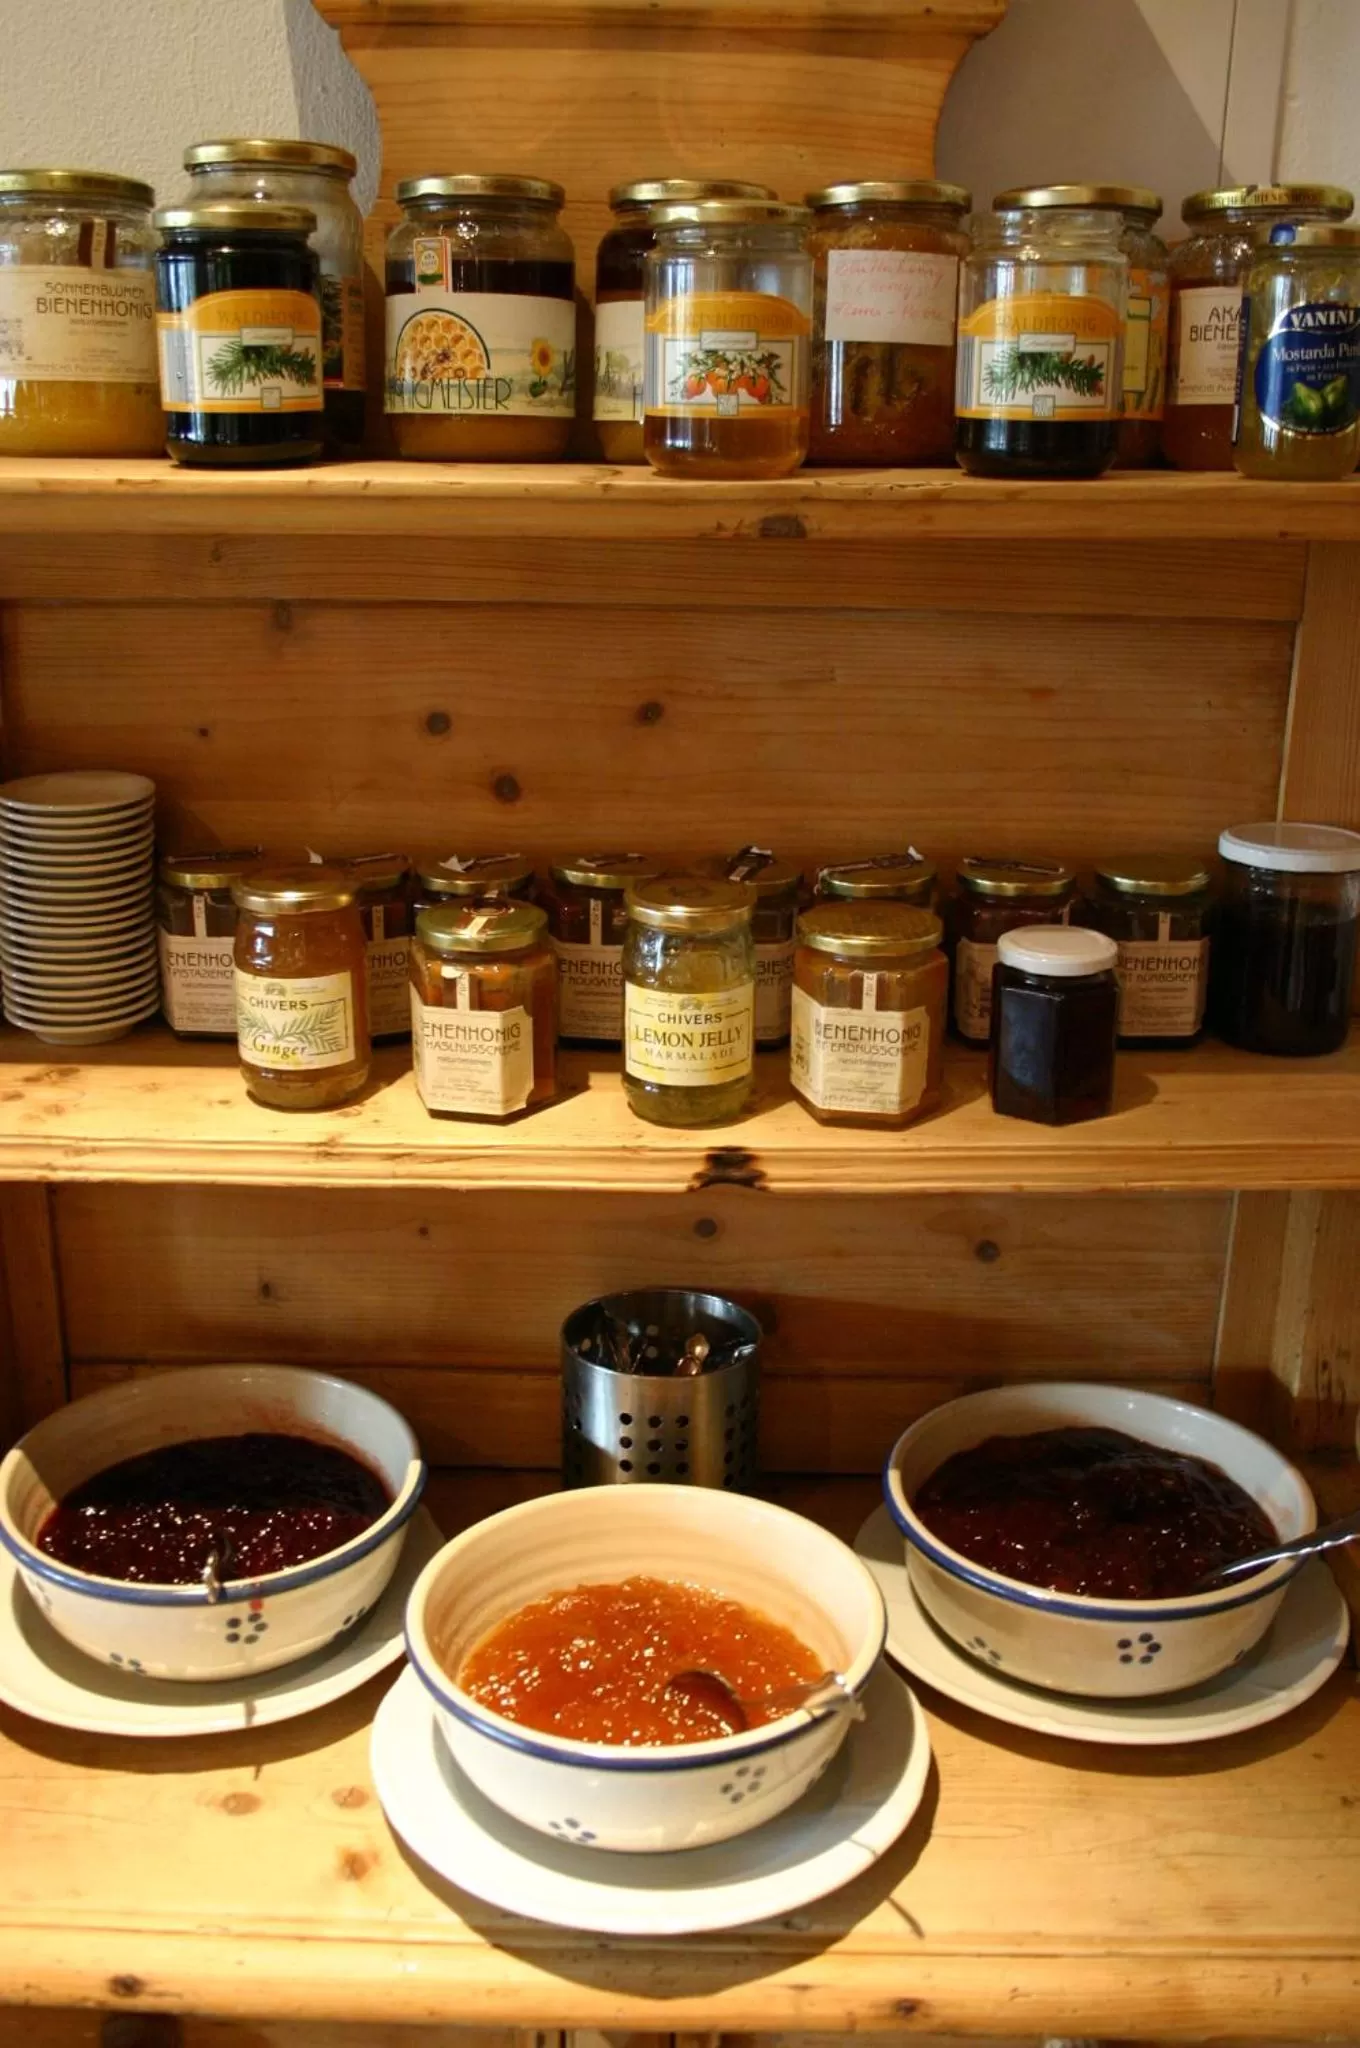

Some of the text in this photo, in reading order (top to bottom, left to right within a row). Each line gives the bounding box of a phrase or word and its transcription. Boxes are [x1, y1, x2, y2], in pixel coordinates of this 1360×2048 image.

[45, 281, 145, 299] SONNENBLUMEN
[36, 297, 153, 320] BIENENHONIG
[1290, 309, 1355, 330] VANINI
[1272, 343, 1336, 362] Mostarda
[249, 996, 309, 1012] CHIVERS
[657, 1011, 724, 1026] CHIVERS
[633, 1024, 744, 1049] LEMON JELLY
[253, 1034, 307, 1061] Ginger
[644, 1046, 735, 1062] MARMALADE
